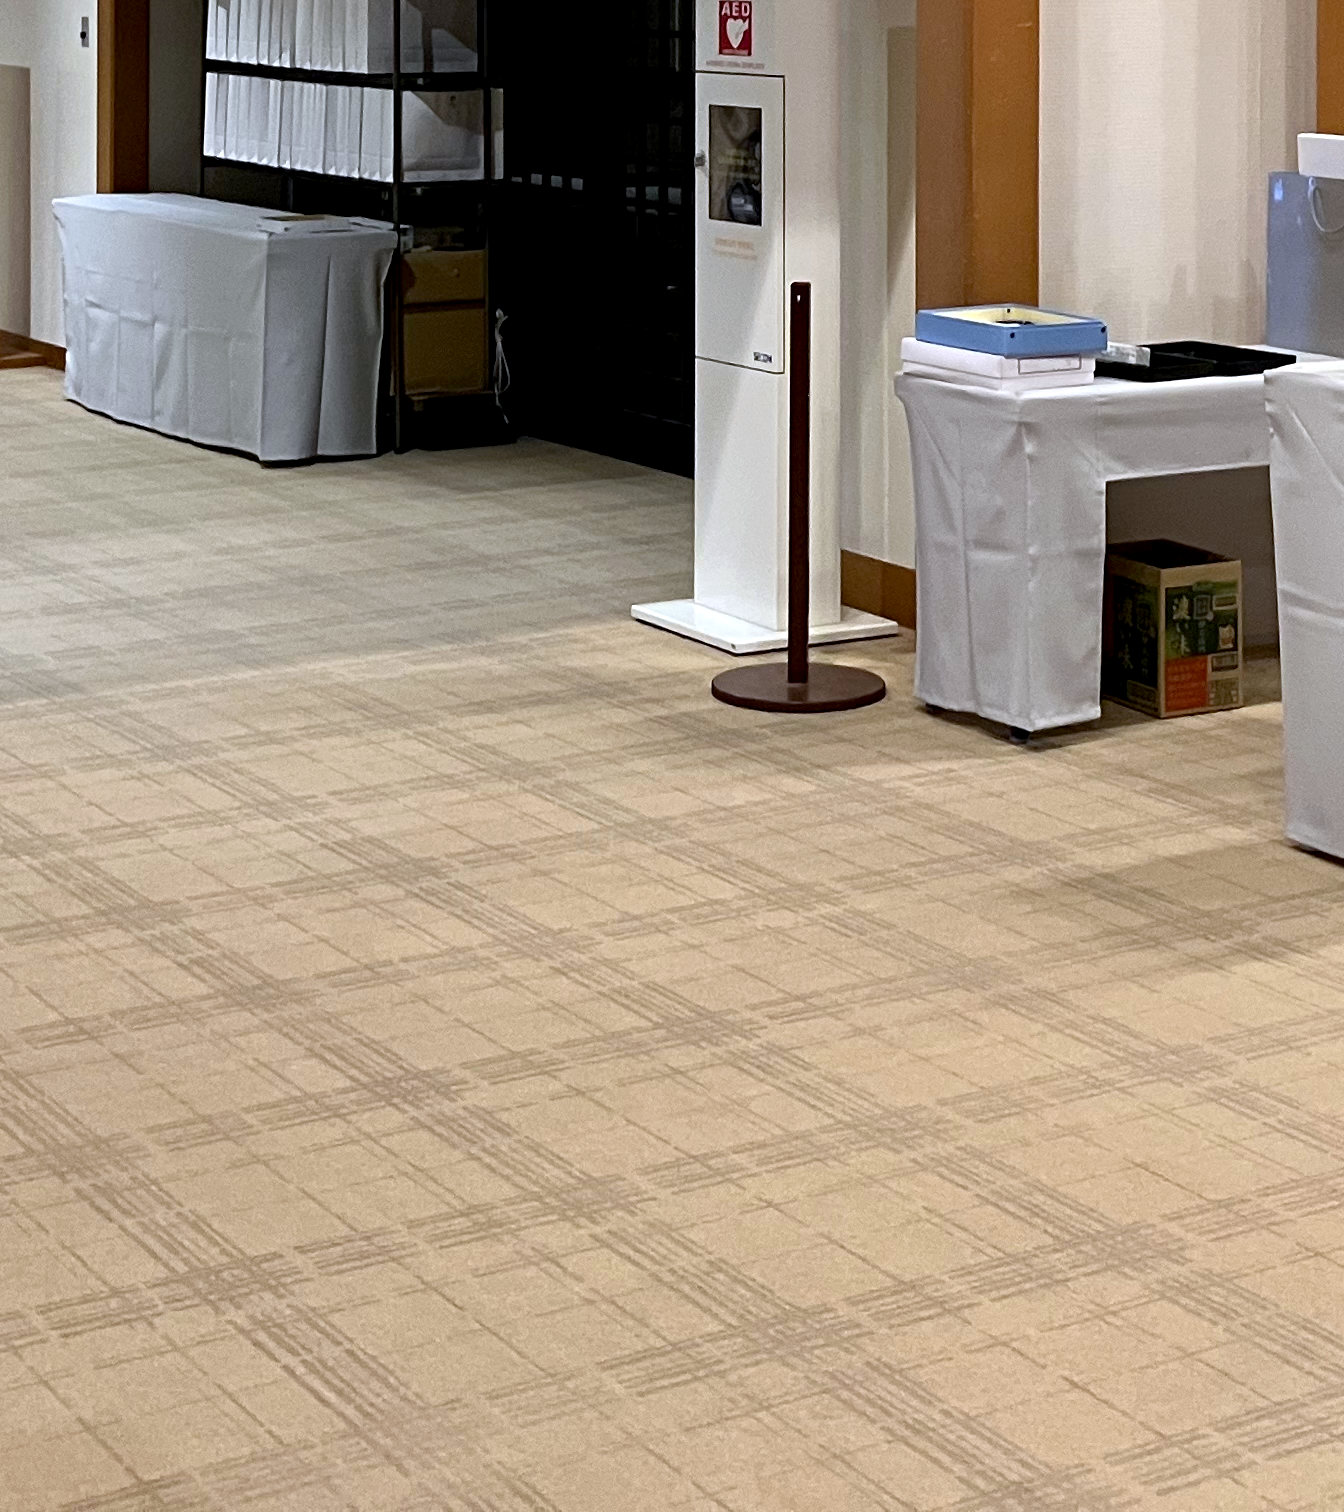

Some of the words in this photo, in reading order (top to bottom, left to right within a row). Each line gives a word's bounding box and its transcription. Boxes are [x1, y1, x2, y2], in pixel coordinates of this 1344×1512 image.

[721, 1, 751, 17] AED
[1170, 594, 1192, 655] 濃い味
